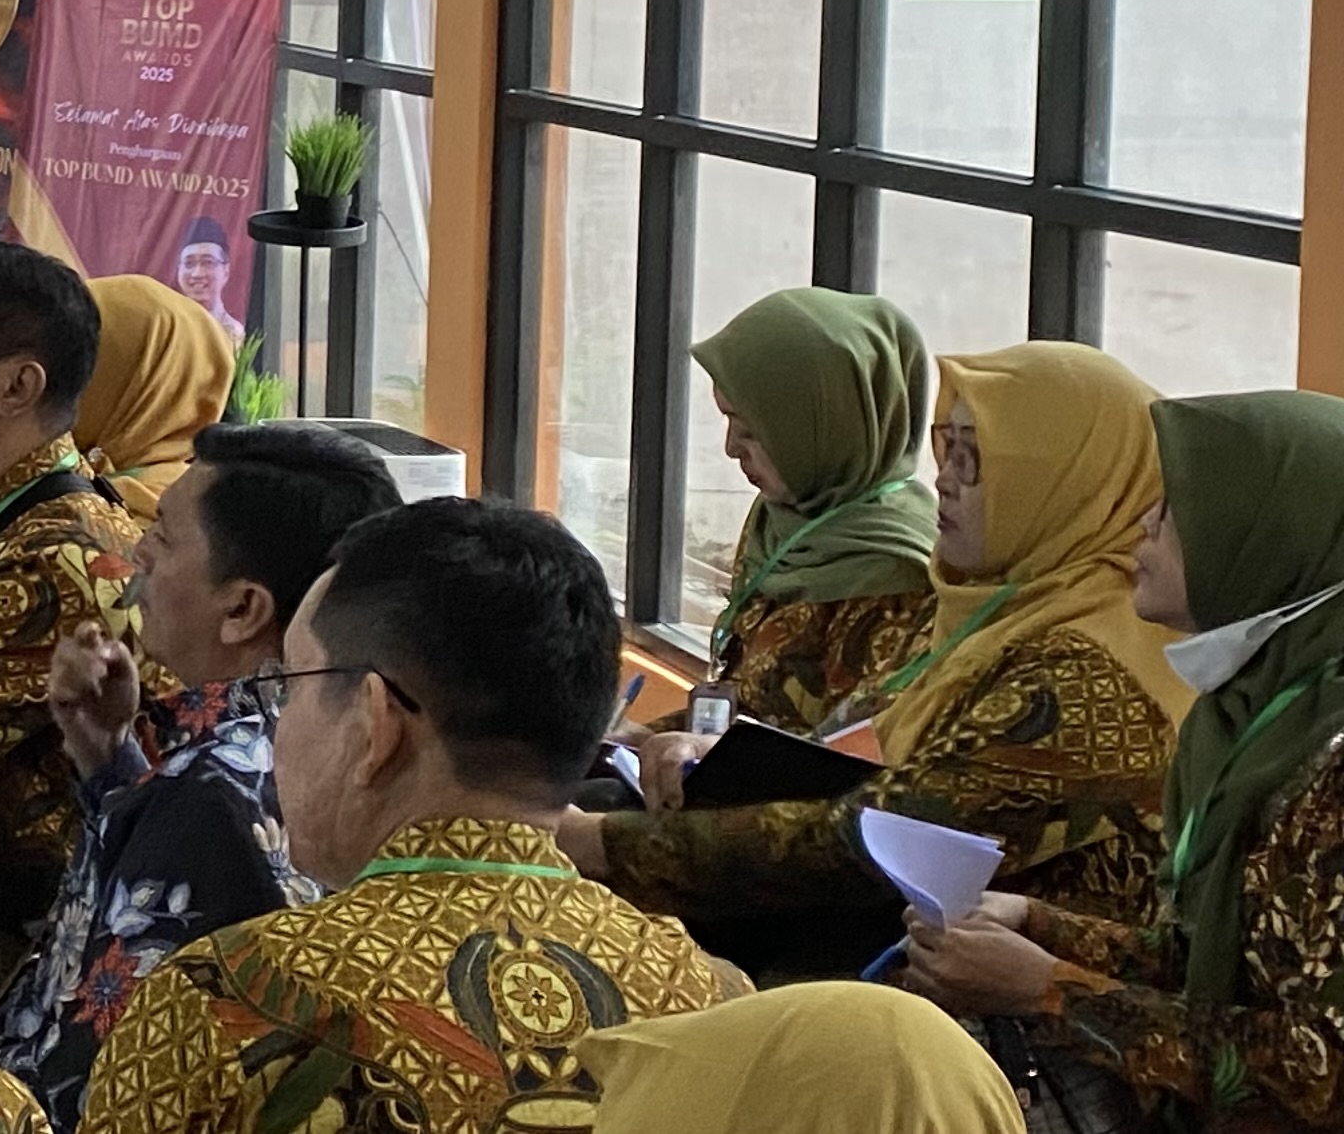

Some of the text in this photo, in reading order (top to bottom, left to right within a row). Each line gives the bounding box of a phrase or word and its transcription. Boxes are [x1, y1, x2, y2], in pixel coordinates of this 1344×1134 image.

[120, 18, 204, 50] BUMD
[139, 66, 175, 83] 2025
[53, 100, 121, 129] Selamat
[108, 141, 182, 162] Penghargaan
[43, 157, 251, 199] TOP BUMD AWARD 2025
